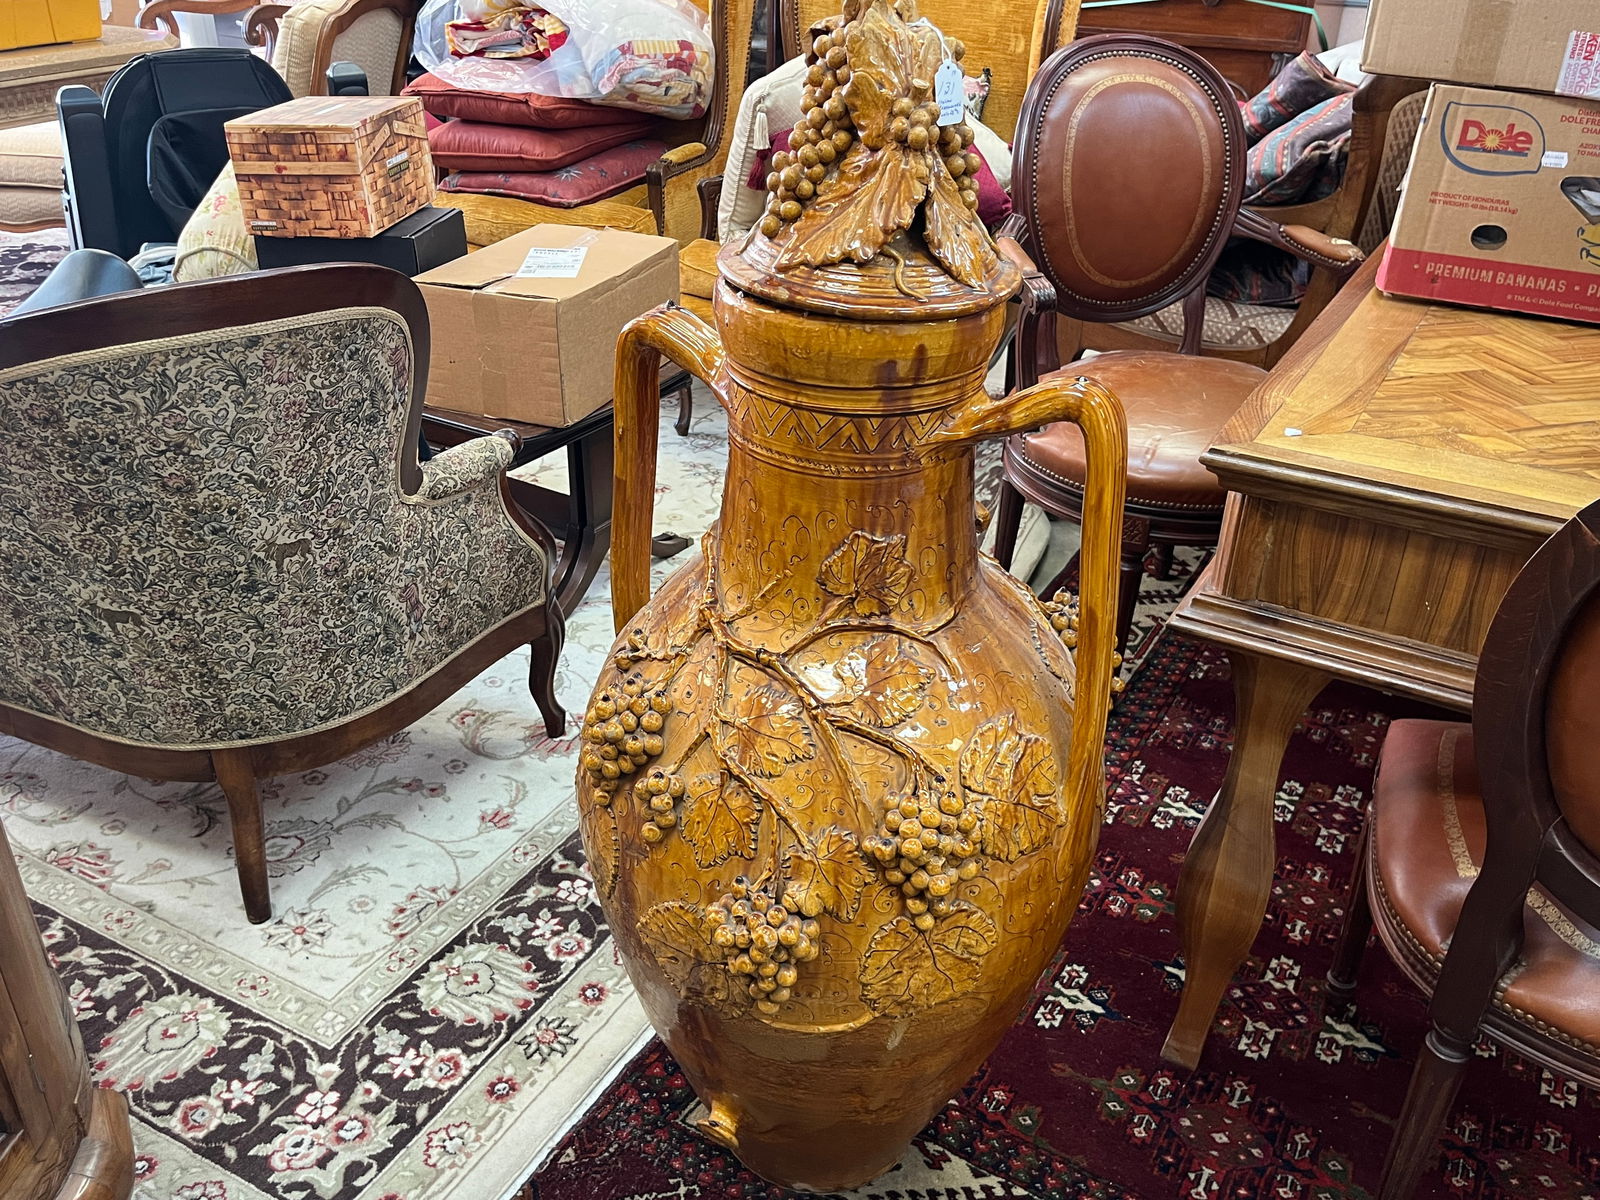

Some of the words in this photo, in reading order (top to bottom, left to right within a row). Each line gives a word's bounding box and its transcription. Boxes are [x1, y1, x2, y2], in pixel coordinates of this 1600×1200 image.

[1560, 115, 1585, 124] DOLE
[1458, 119, 1533, 152] Dole
[1430, 191, 1462, 200] PRODUCT
[1473, 196, 1510, 206] HONDURAS
[1425, 261, 1494, 284] PREMIUM
[1496, 270, 1567, 293] BANANAS
[1539, 298, 1555, 307] Dole
[1556, 301, 1574, 309] Food
